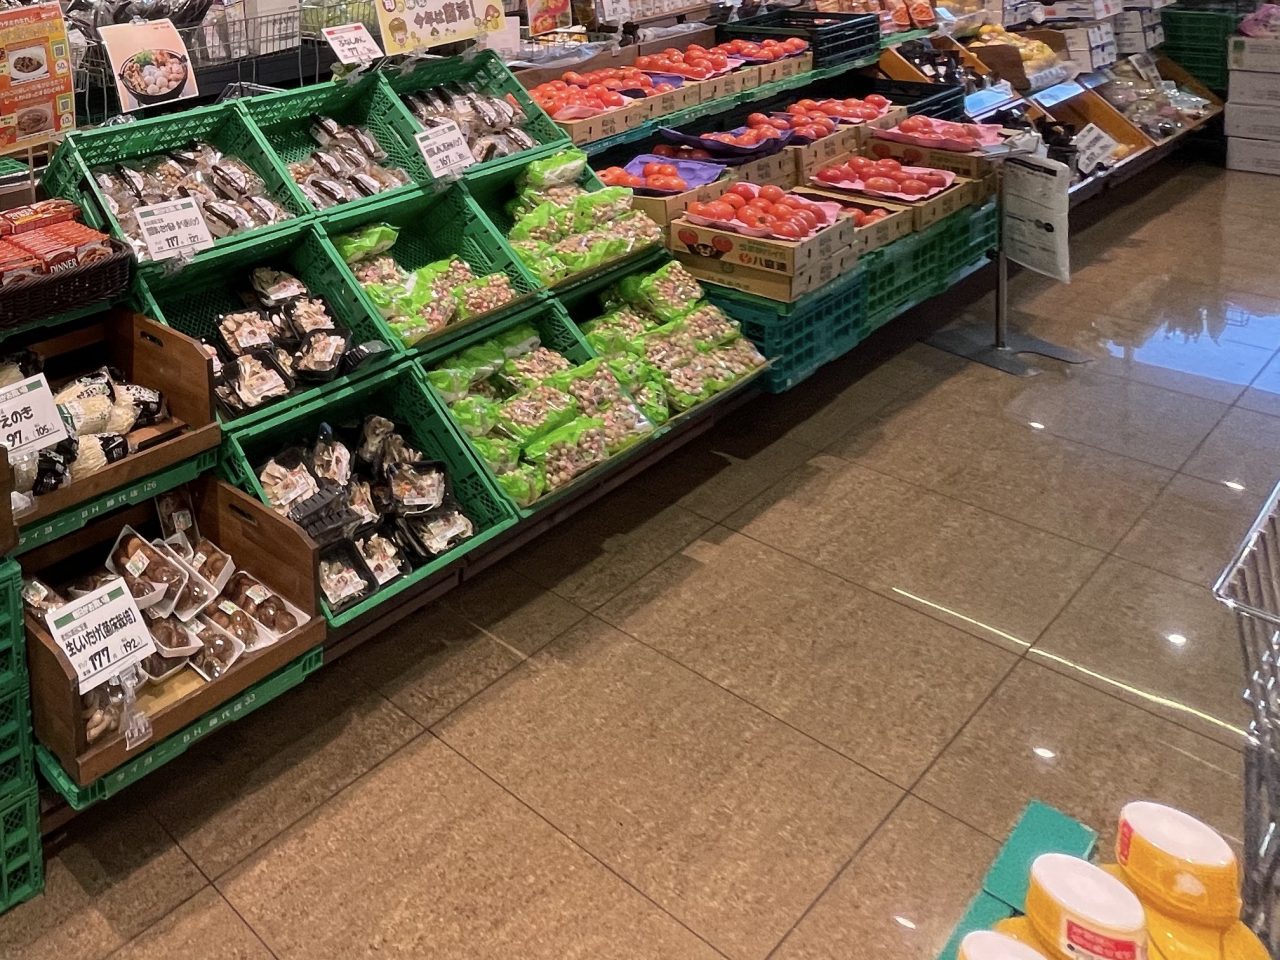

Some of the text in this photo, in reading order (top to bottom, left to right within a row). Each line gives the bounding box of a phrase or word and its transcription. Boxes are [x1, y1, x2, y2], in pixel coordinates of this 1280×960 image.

[49, 257, 79, 275] DINNER
[0, 405, 34, 430] えのき
[6, 424, 50, 448] 97 105
[88, 646, 111, 671] 177
